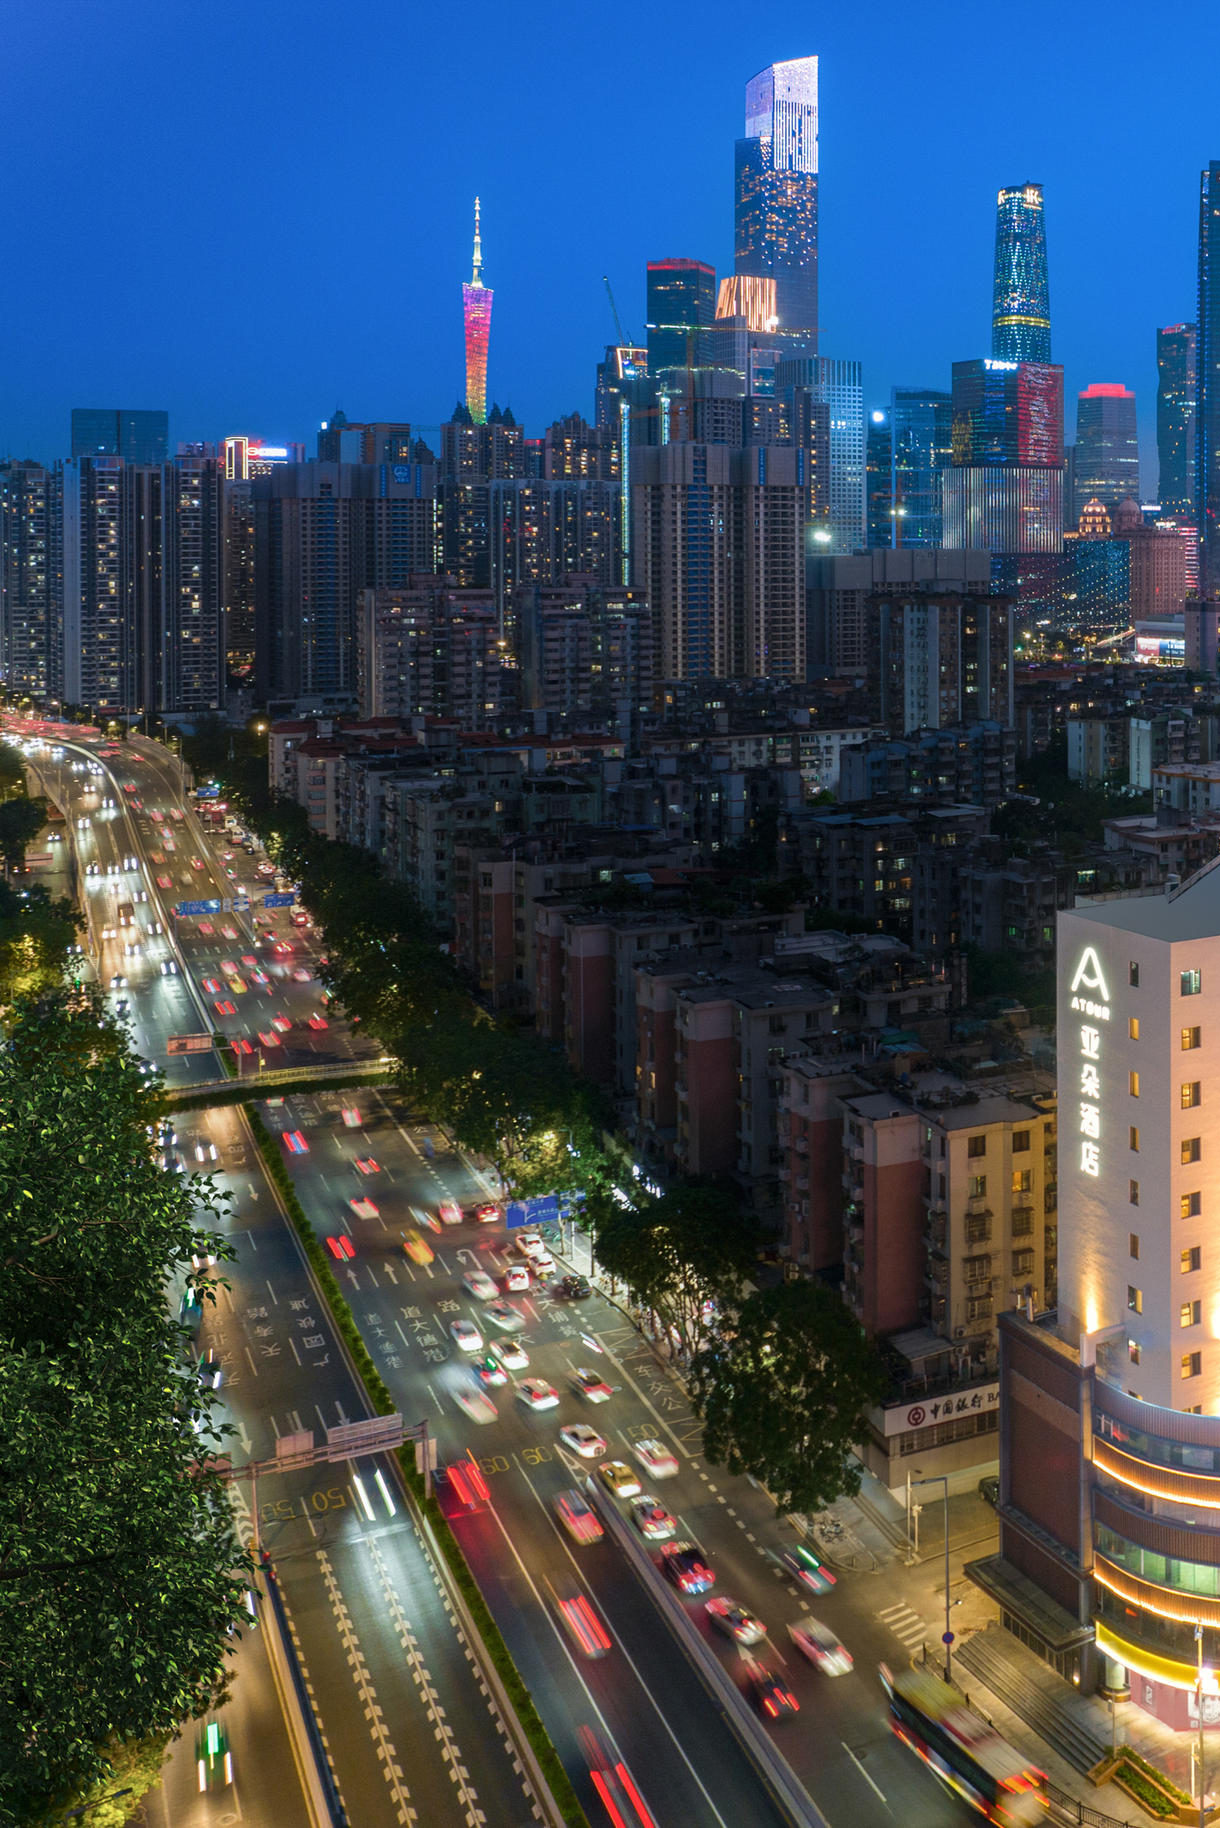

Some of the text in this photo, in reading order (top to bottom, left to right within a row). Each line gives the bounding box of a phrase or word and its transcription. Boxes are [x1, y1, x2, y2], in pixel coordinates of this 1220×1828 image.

[1071, 996, 1111, 1021] ATOUR
[1080, 1025, 1101, 1178] 亚朵酒店
[931, 1394, 983, 1419] 中国银行
[479, 1455, 510, 1475] 60
[312, 1488, 347, 1512] 50
